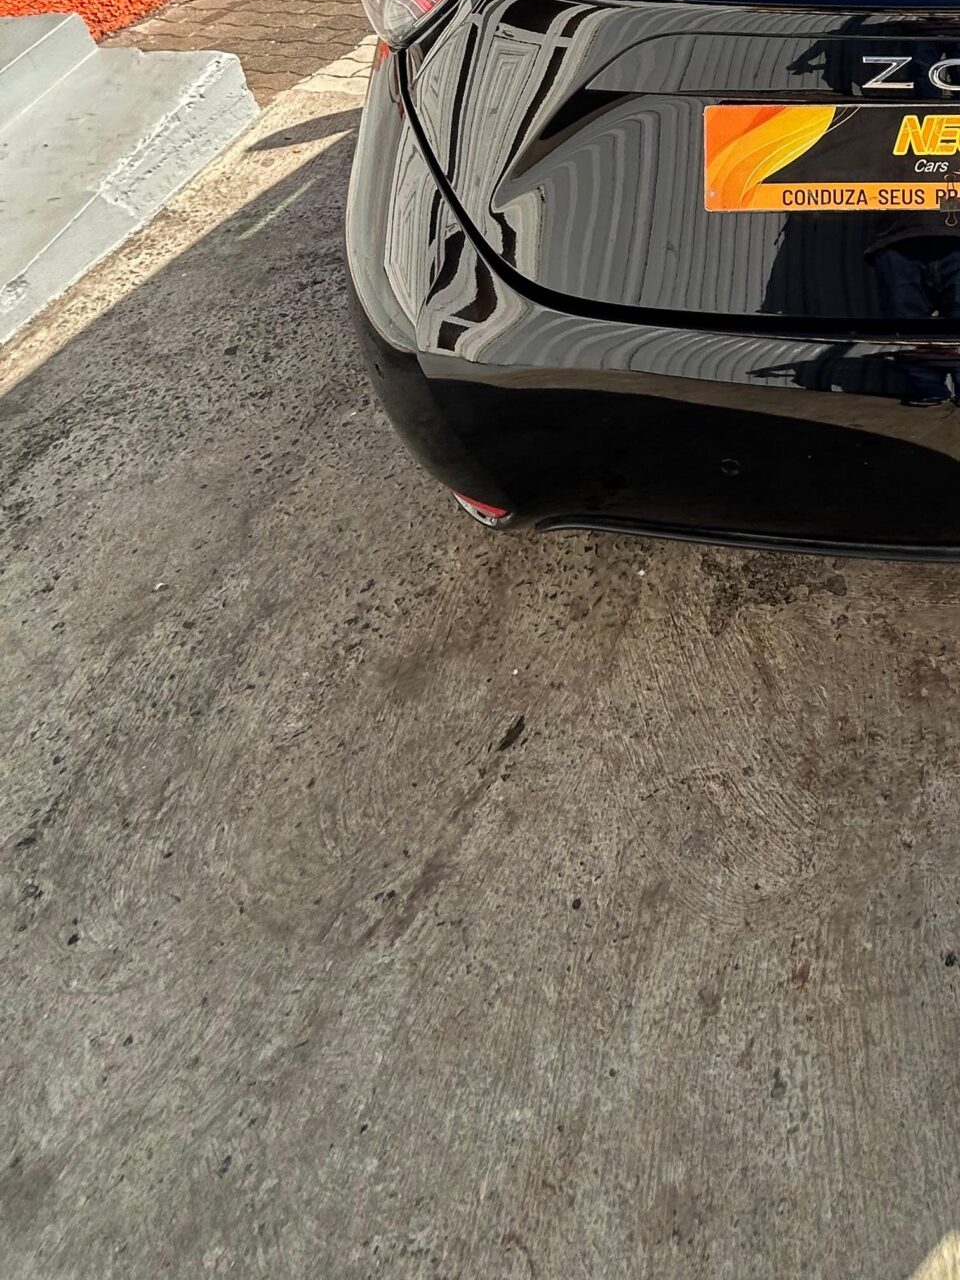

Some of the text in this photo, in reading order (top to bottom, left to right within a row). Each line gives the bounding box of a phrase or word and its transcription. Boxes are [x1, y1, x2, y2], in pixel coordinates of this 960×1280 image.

[914, 158, 949, 173] Cars
[782, 188, 868, 206] CONDUZA
[878, 188, 925, 205] SEUS
